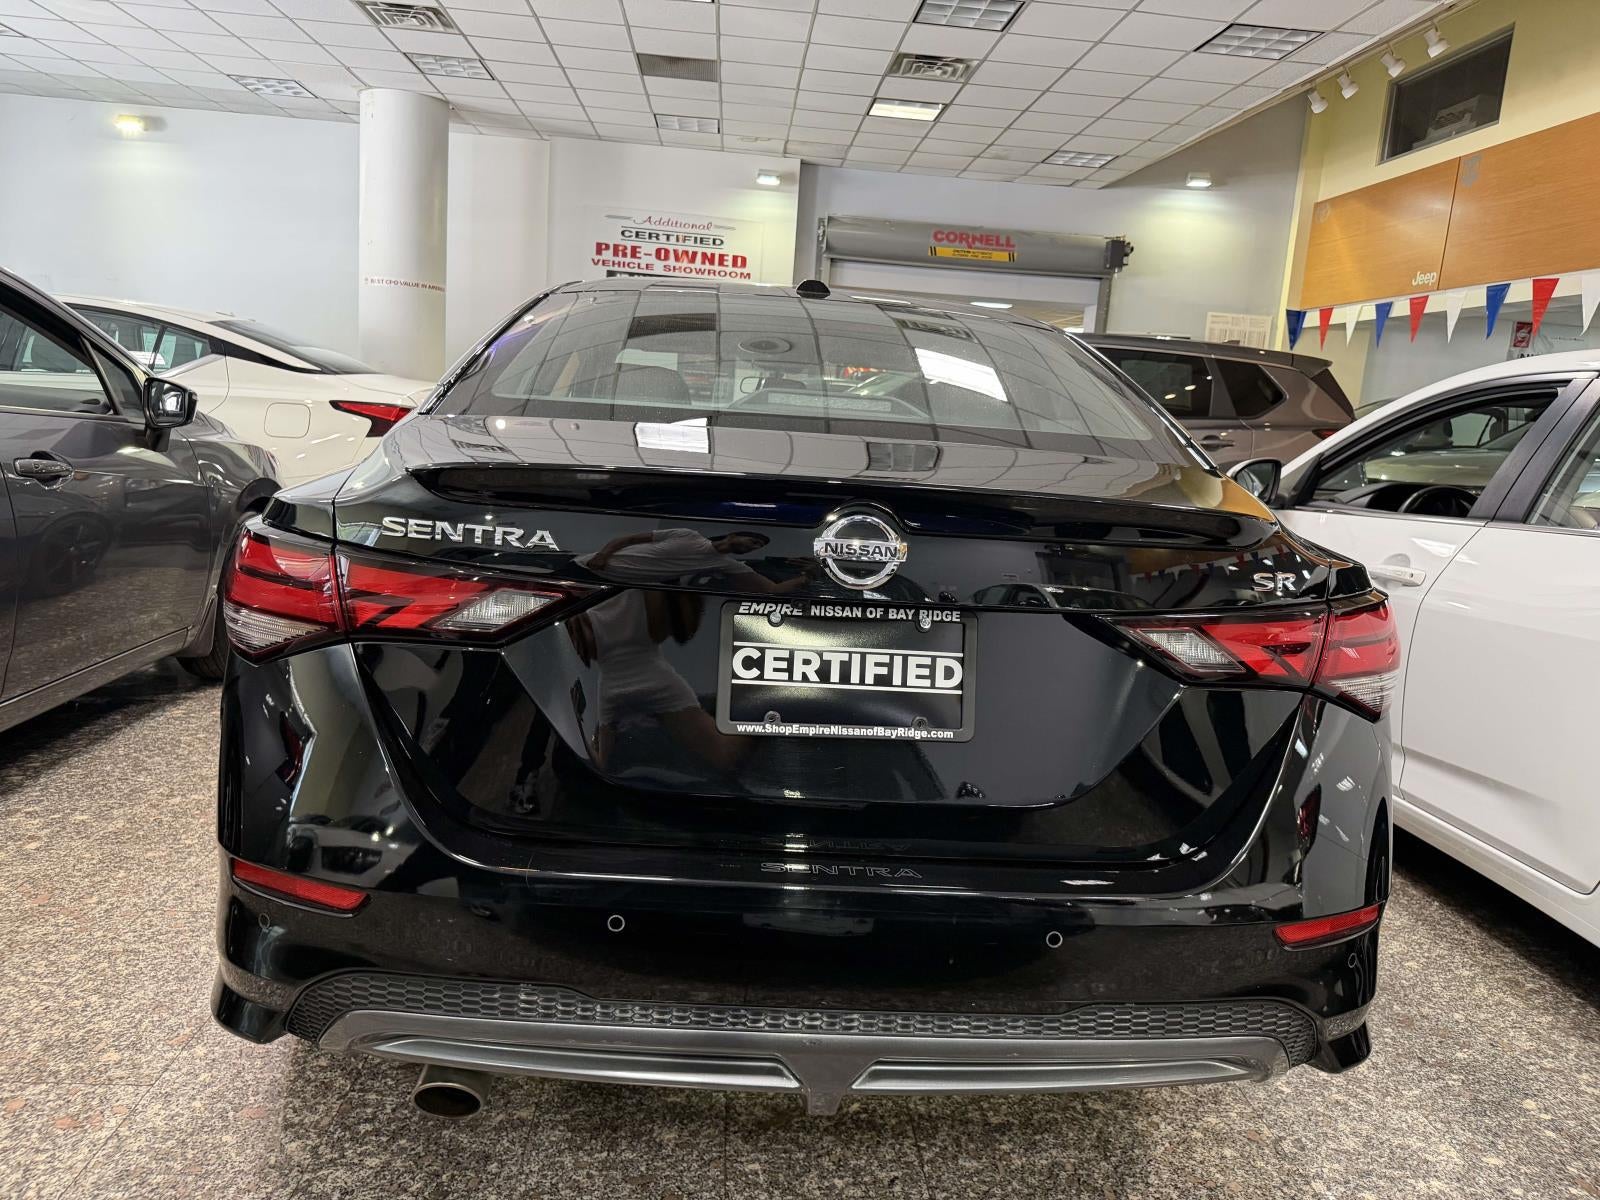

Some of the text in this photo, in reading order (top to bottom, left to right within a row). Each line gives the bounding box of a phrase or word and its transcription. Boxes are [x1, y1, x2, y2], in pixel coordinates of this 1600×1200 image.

[634, 215, 713, 231] Additional
[620, 229, 724, 246] CERTIFIED
[932, 230, 1016, 249] CORNELL
[595, 241, 748, 269] PRE-OWNED
[591, 258, 655, 271] VEHICLE
[663, 264, 752, 280] SHOWROOM
[399, 280, 419, 288] VALUE
[1411, 271, 1437, 286] Jeep
[382, 516, 560, 551] SENTRA
[824, 542, 898, 558] NISSAN
[1251, 571, 1297, 592] SR
[738, 602, 961, 622] EMPIRE NISSAN OF BAY RIDGE
[732, 647, 963, 688] CERTIFIED
[736, 723, 954, 739] www.ShopEmpireNissanofBayRidge.com
[760, 862, 923, 879] SENTRA
